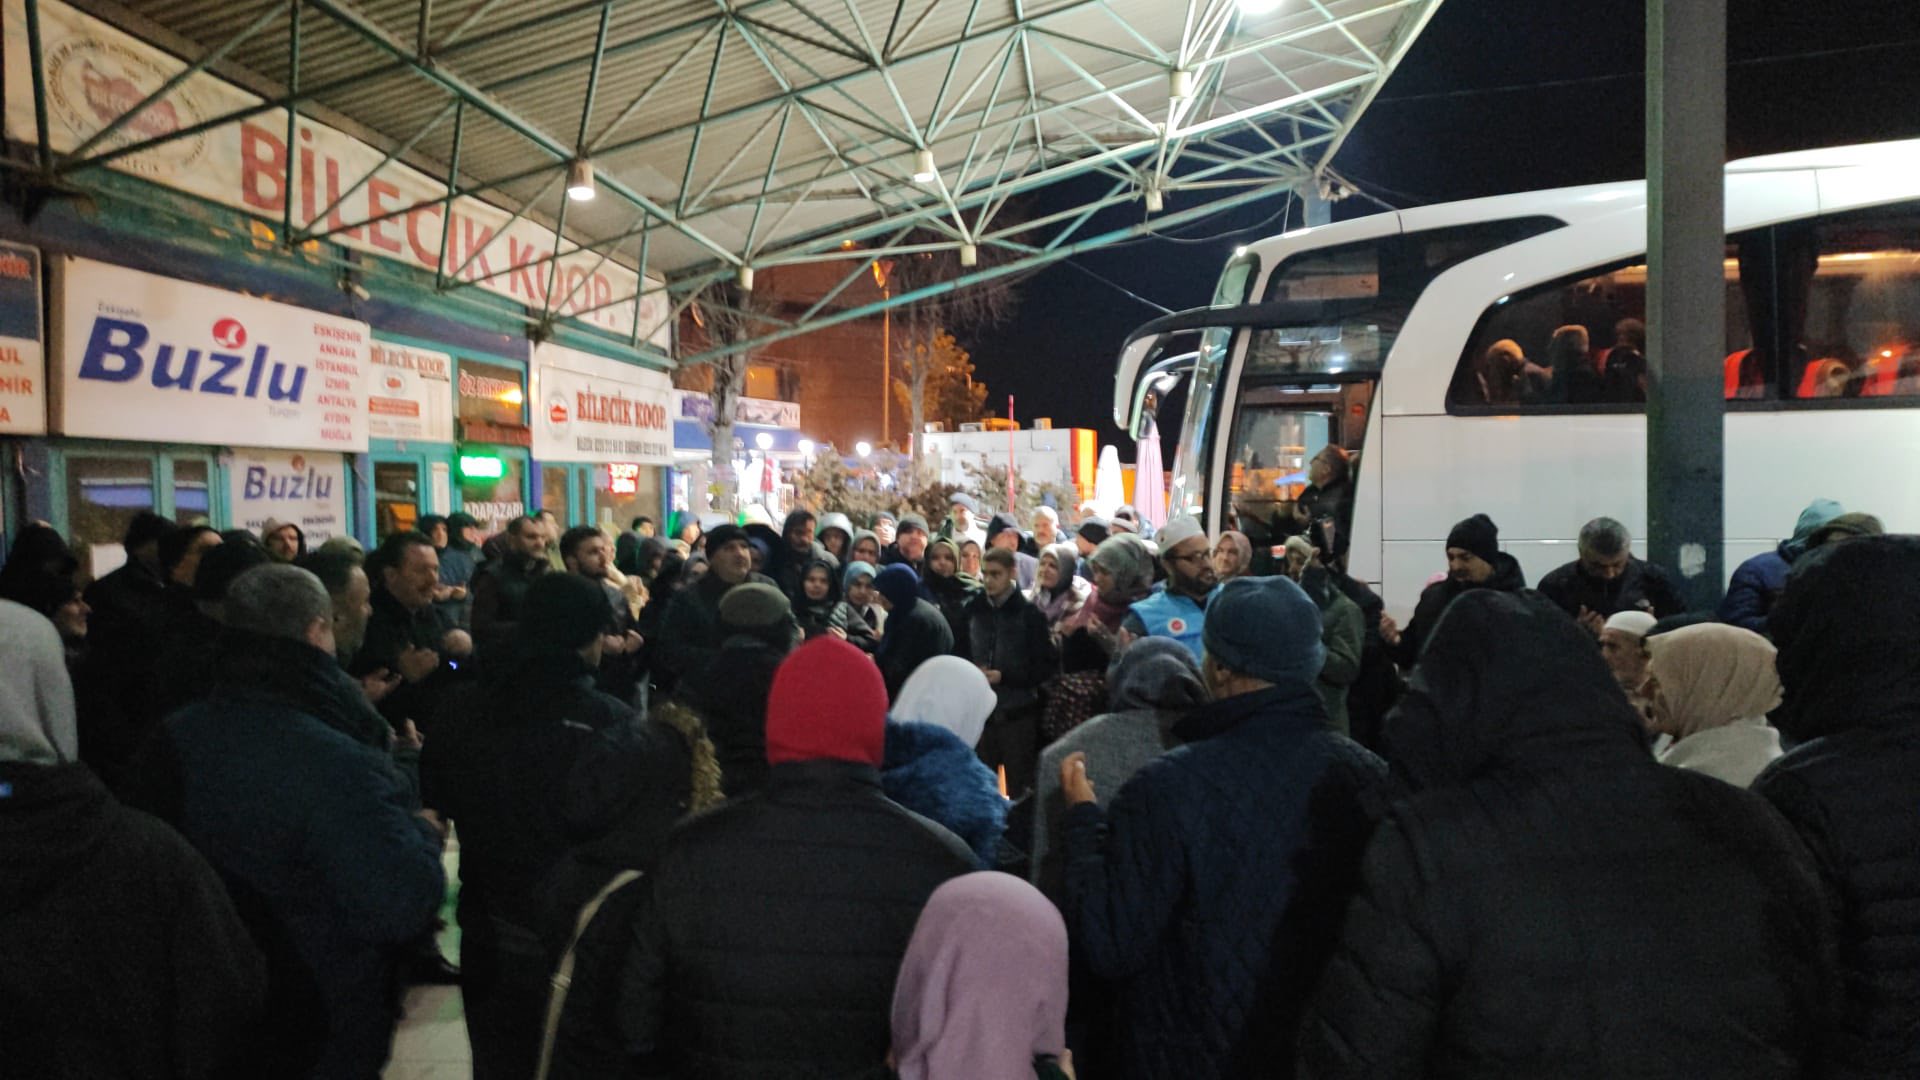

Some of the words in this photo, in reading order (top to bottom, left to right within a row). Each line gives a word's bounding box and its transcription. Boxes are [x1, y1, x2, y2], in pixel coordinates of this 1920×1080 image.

[78, 316, 308, 403] Buzlu
[318, 394, 357, 409] ANTALYA
[576, 383, 632, 427] BİLECİK
[635, 401, 668, 432] KOOP.
[243, 465, 333, 501] Buzlu
